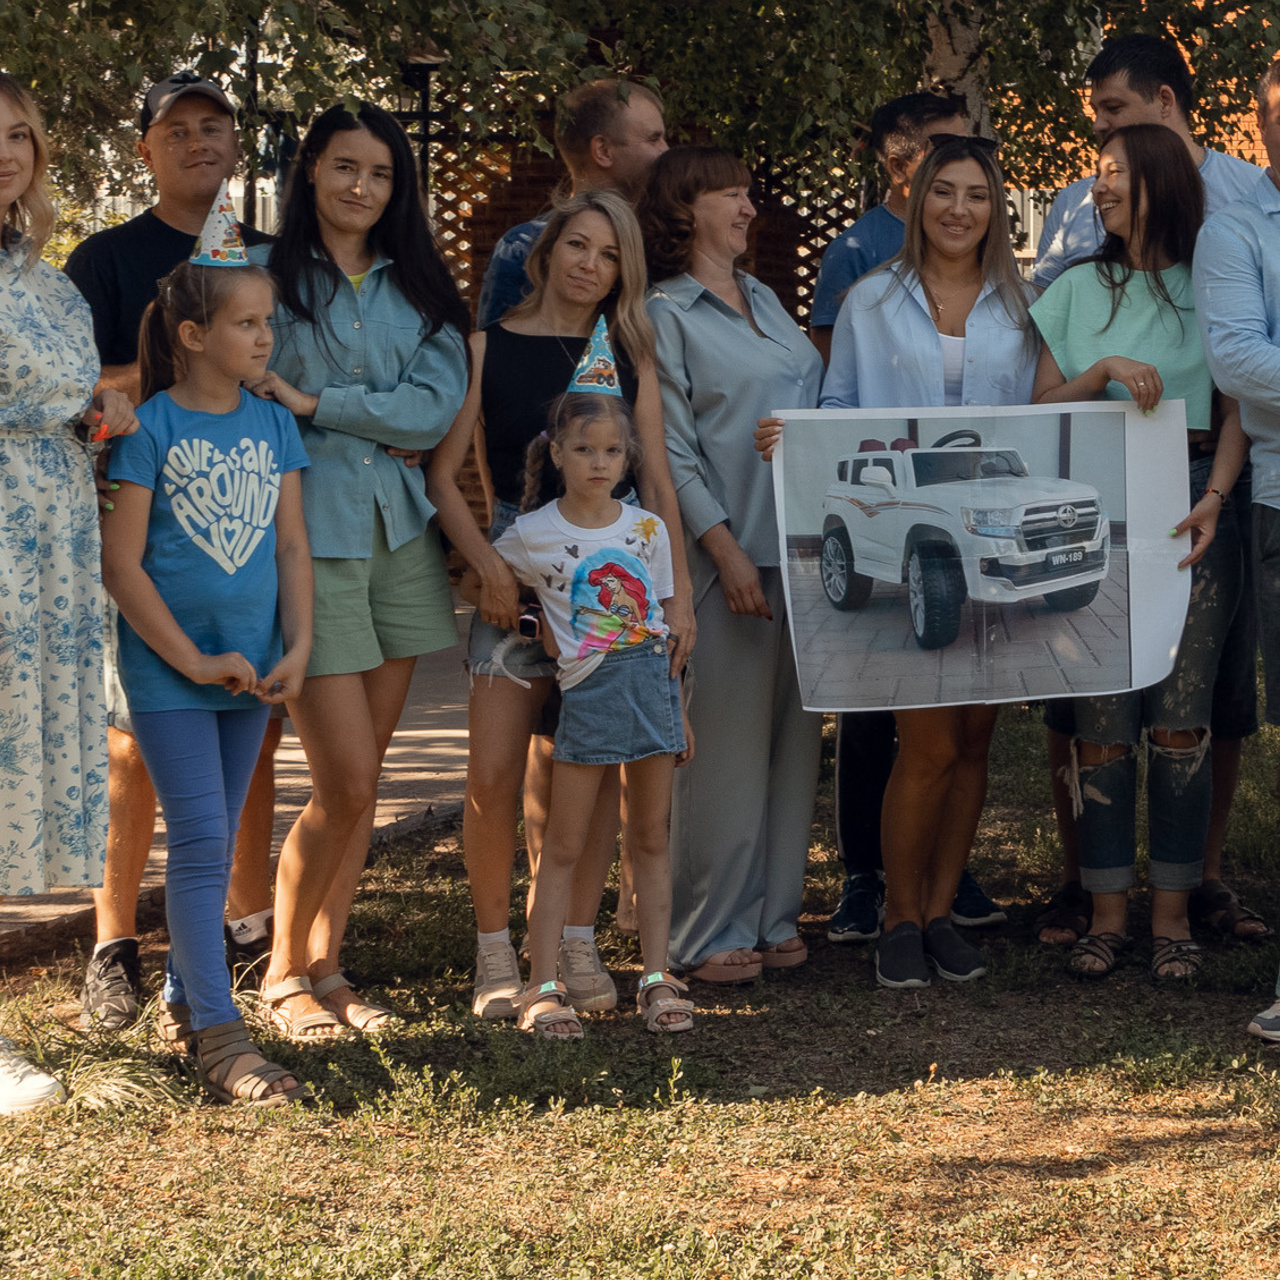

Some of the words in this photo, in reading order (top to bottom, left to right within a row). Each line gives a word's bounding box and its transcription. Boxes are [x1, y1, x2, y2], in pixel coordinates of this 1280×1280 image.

[163, 438, 214, 488] LOVE
[170, 462, 280, 538] AROUND
[191, 515, 266, 575] YOU
[1051, 551, 1083, 566] WN-189
